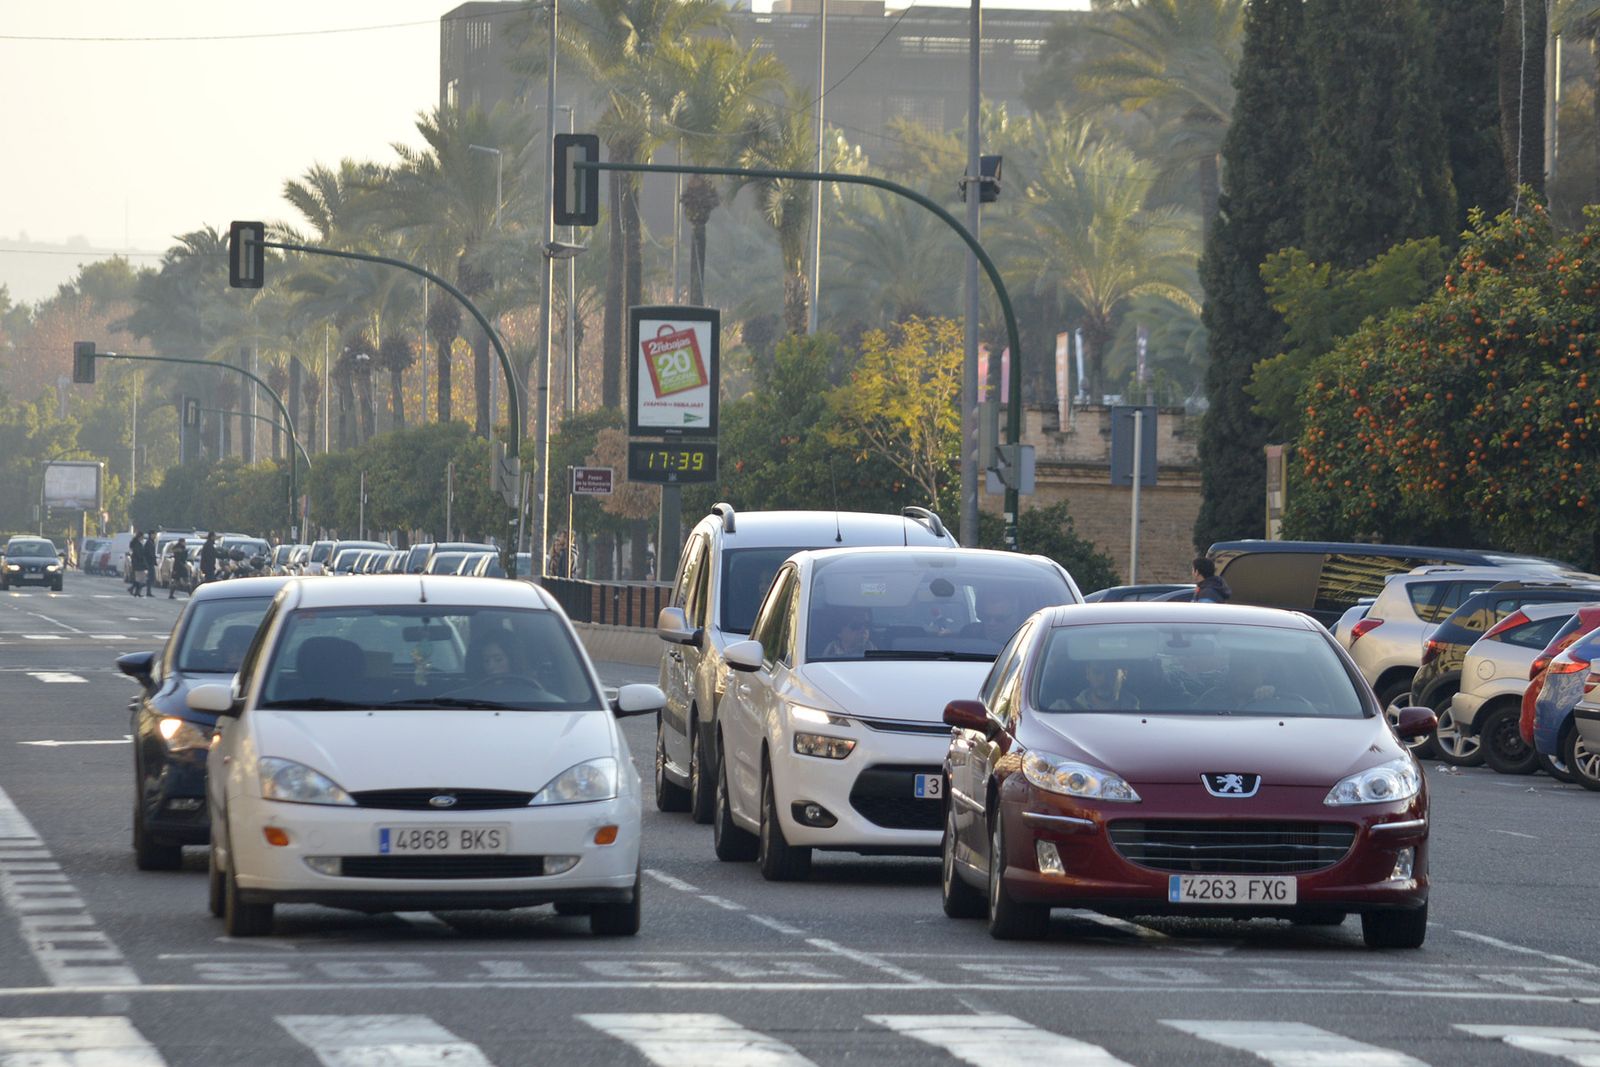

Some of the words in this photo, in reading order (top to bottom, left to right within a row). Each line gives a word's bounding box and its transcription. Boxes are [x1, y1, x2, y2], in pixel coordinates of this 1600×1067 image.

[658, 350, 691, 377] 20
[648, 452, 704, 470] 17:39
[396, 829, 449, 850] 4868
[460, 829, 500, 850] BKS
[1184, 879, 1237, 899] 4263
[1248, 880, 1287, 900] FXG
